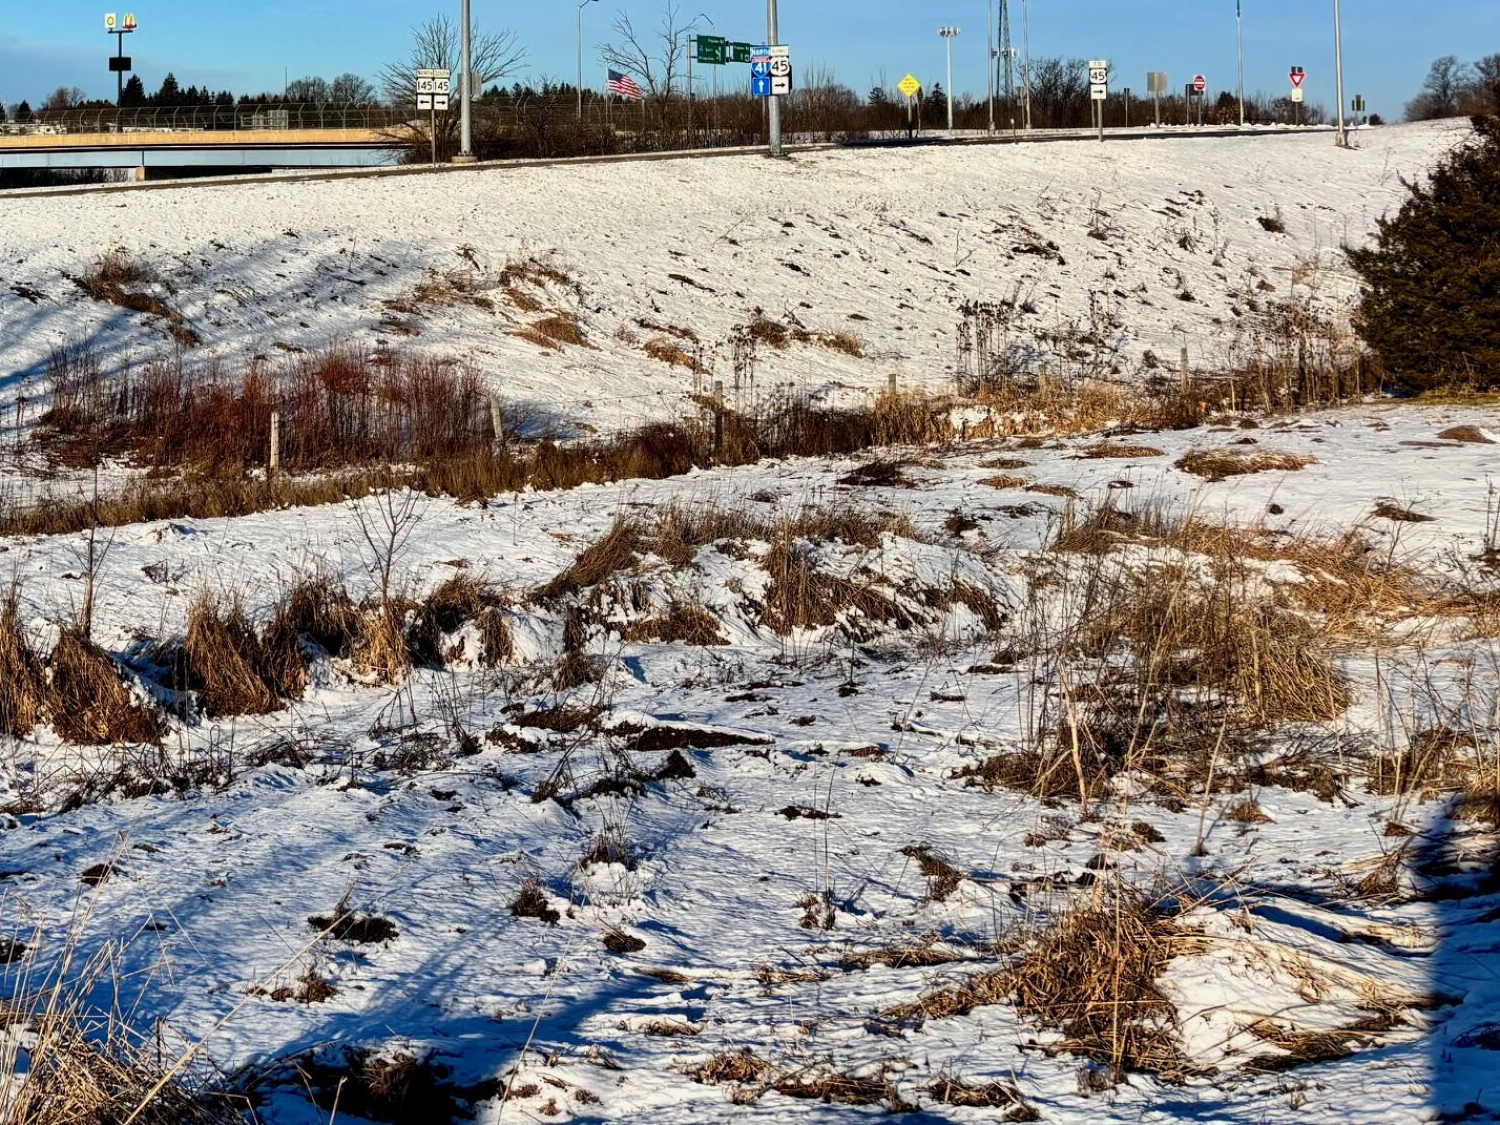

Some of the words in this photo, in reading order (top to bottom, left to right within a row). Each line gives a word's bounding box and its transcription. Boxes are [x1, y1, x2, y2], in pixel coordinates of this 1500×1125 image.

[754, 62, 768, 74] 41
[771, 60, 788, 72] 45
[1091, 71, 1105, 81] 45
[417, 81, 432, 91] 145
[434, 81, 449, 91] 145
